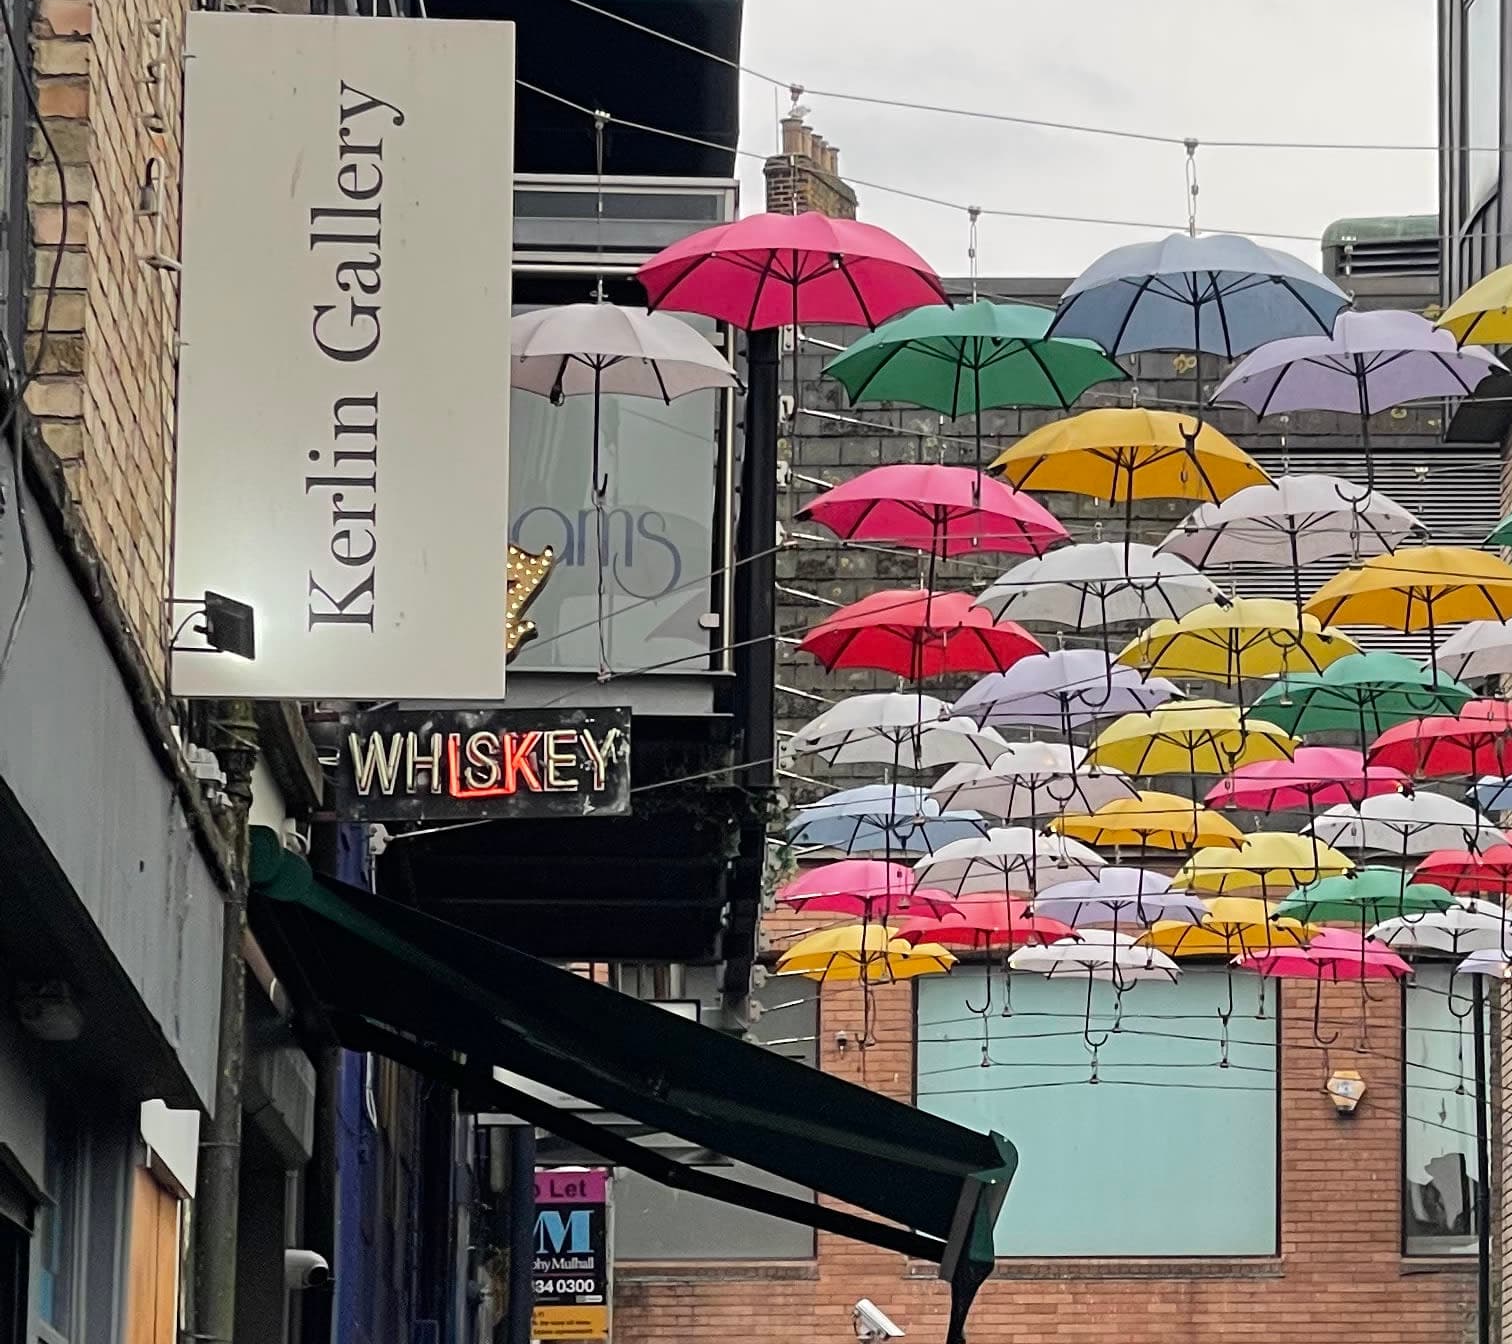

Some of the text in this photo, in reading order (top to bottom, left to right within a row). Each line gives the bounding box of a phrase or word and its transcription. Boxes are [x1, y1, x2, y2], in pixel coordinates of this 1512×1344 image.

[305, 79, 405, 633] Kerlin Gallery
[511, 506, 682, 600] ams
[349, 728, 623, 798] WHISKEY
[550, 1179, 587, 1197] Let
[531, 1279, 595, 1293] 34 0300
